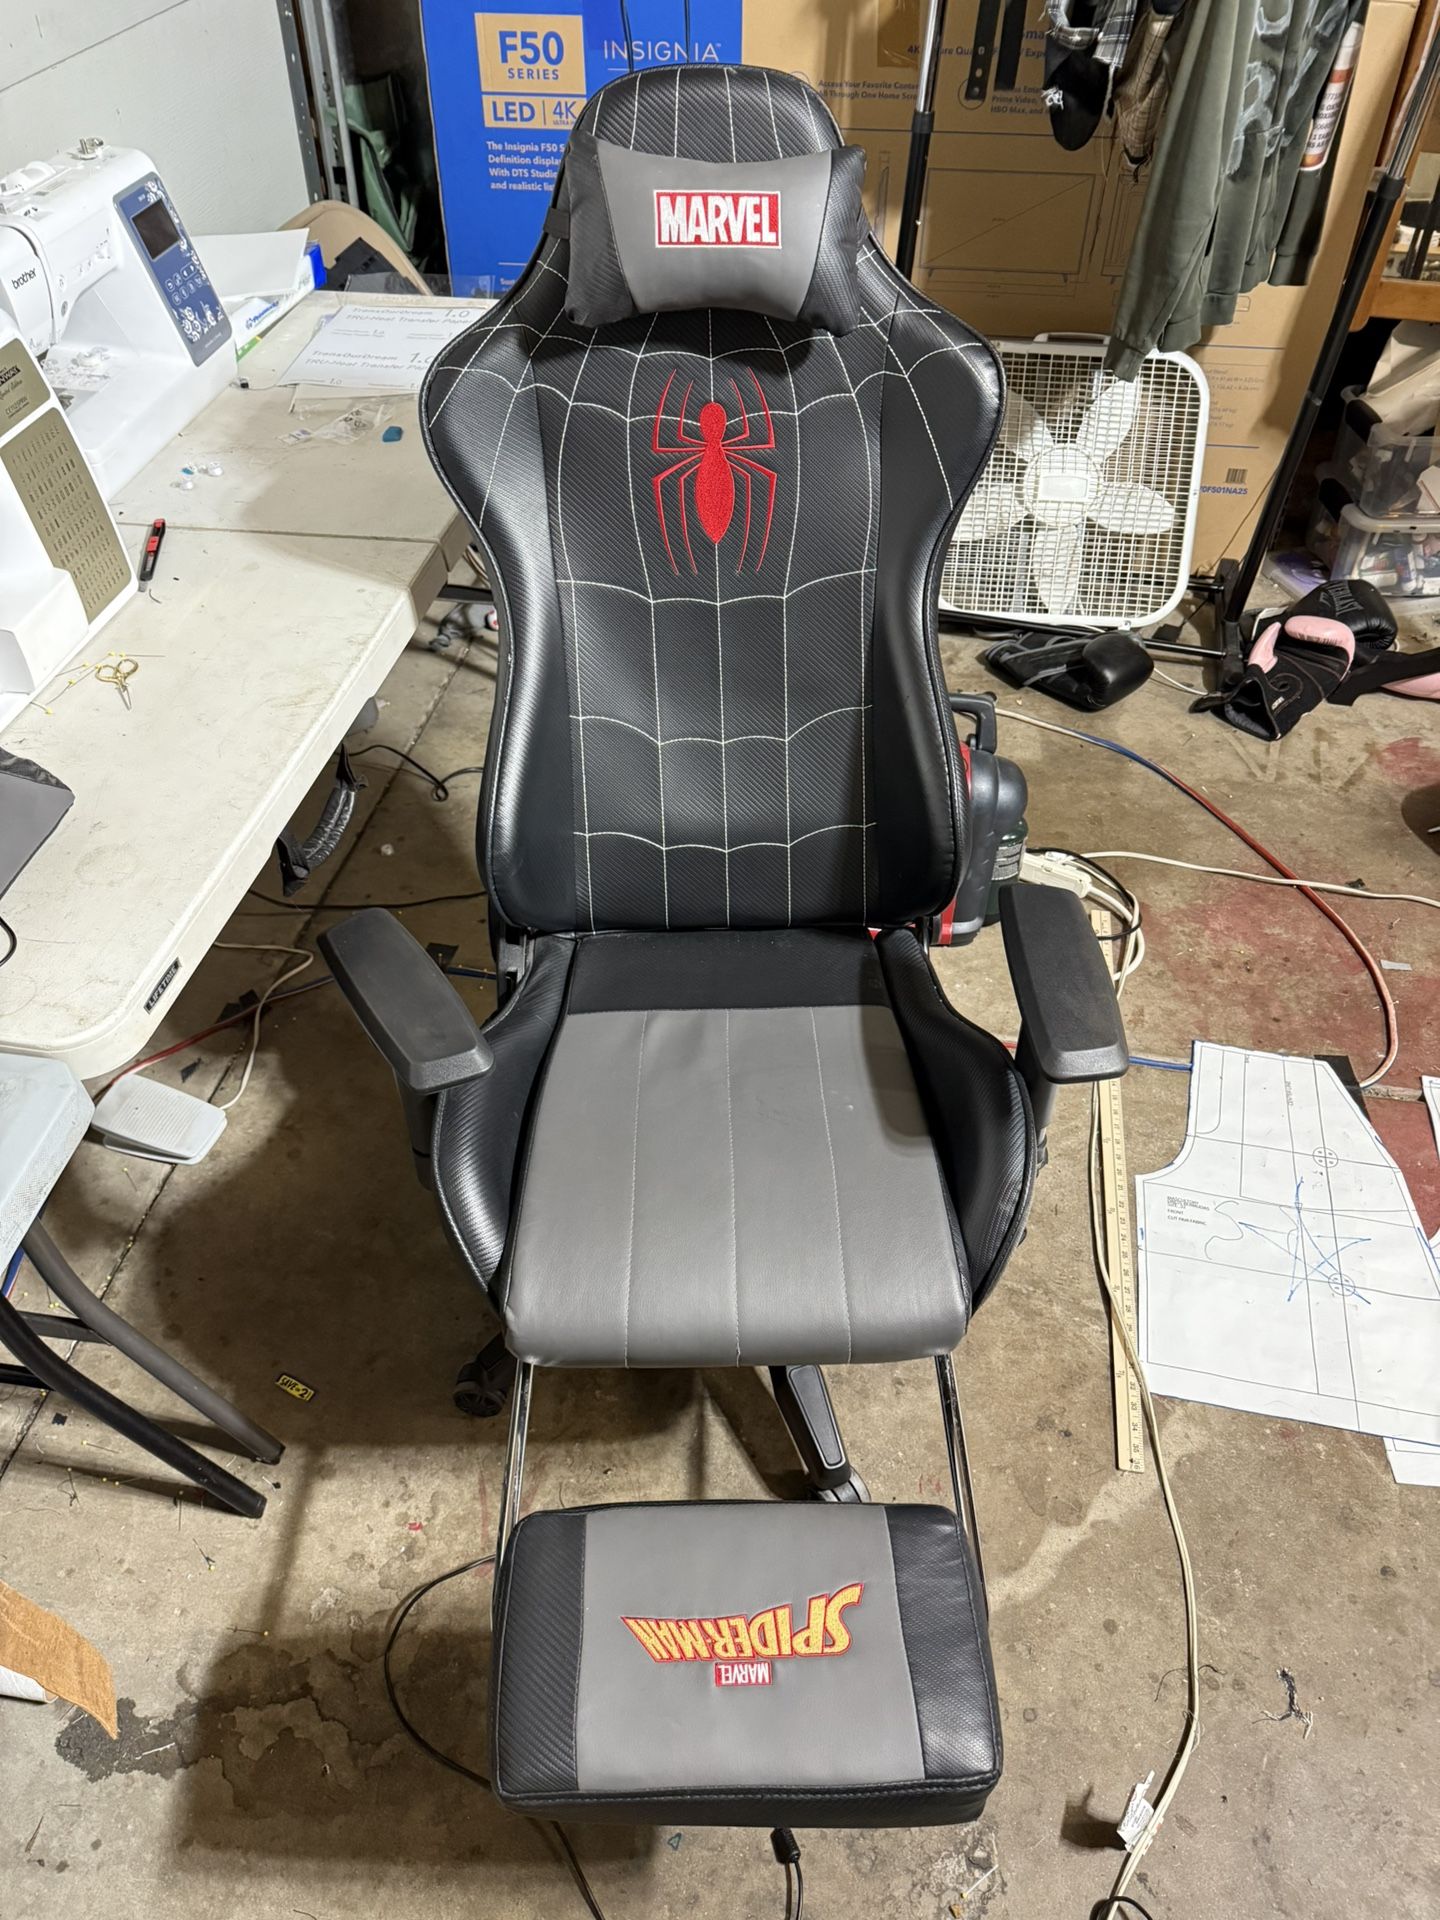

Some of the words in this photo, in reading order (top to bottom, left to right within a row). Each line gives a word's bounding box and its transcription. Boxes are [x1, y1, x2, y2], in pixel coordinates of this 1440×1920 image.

[498, 30, 565, 66] F50
[603, 39, 720, 62] INSIGNIA
[507, 67, 560, 81] SERIES
[491, 100, 536, 123] LED
[552, 100, 577, 120] 4K
[486, 140, 503, 151] The
[504, 141, 539, 154] Insignia
[540, 142, 558, 153] F50
[487, 154, 532, 165] Definition
[488, 167, 510, 177] With
[511, 168, 529, 178] DTS
[490, 180, 507, 190] and
[508, 181, 542, 192] realistic
[658, 194, 778, 244] MARVEL
[11, 267, 37, 290] brother
[445, 308, 471, 318] 1.0
[148, 965, 178, 1007] LIFETIME
[619, 1581, 865, 1664] SPIDER-MAN
[717, 1662, 771, 1685] MARVEL
